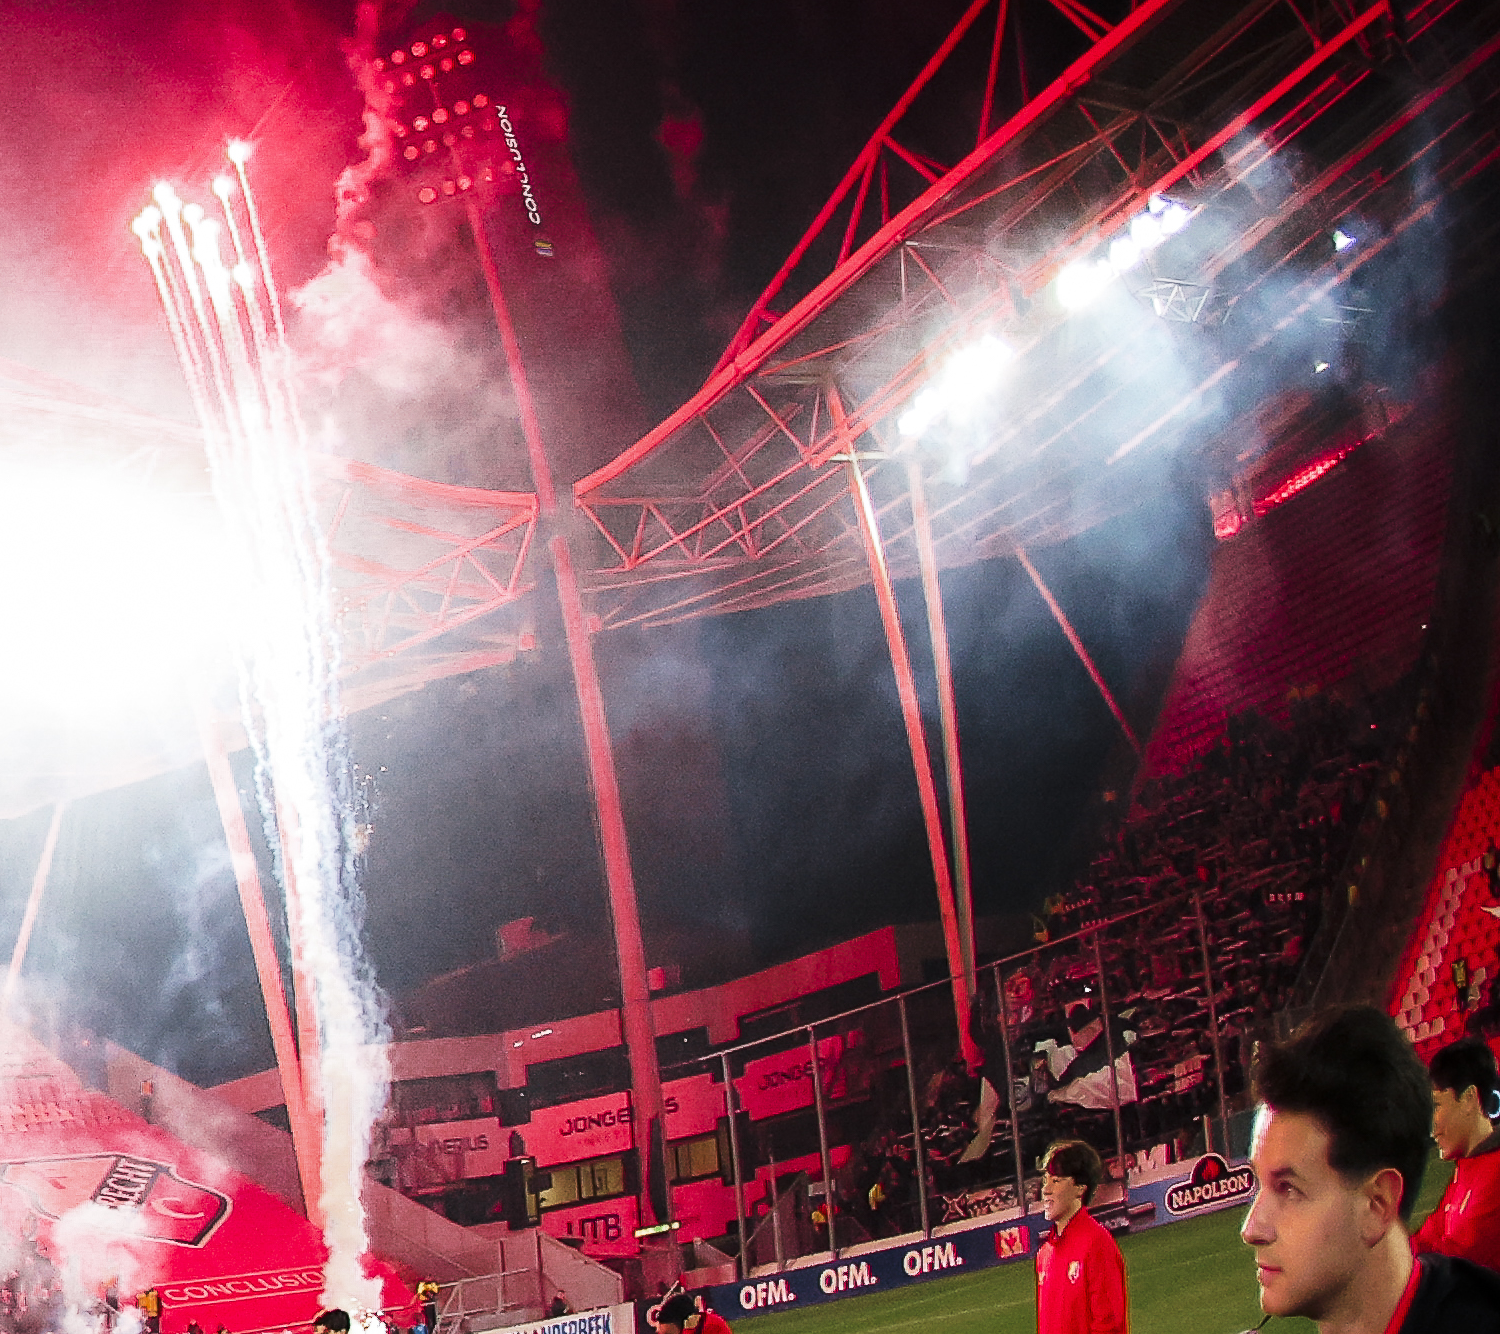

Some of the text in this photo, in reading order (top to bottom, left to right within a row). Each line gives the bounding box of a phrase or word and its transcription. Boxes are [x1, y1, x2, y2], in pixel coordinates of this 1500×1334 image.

[1171, 1172, 1251, 1209] NAPOLEON
[903, 1241, 964, 1277] OFM.
[163, 1269, 325, 1303] CONCLUSIO
[739, 1278, 797, 1310] OFM.
[820, 1261, 879, 1294] OFM.
